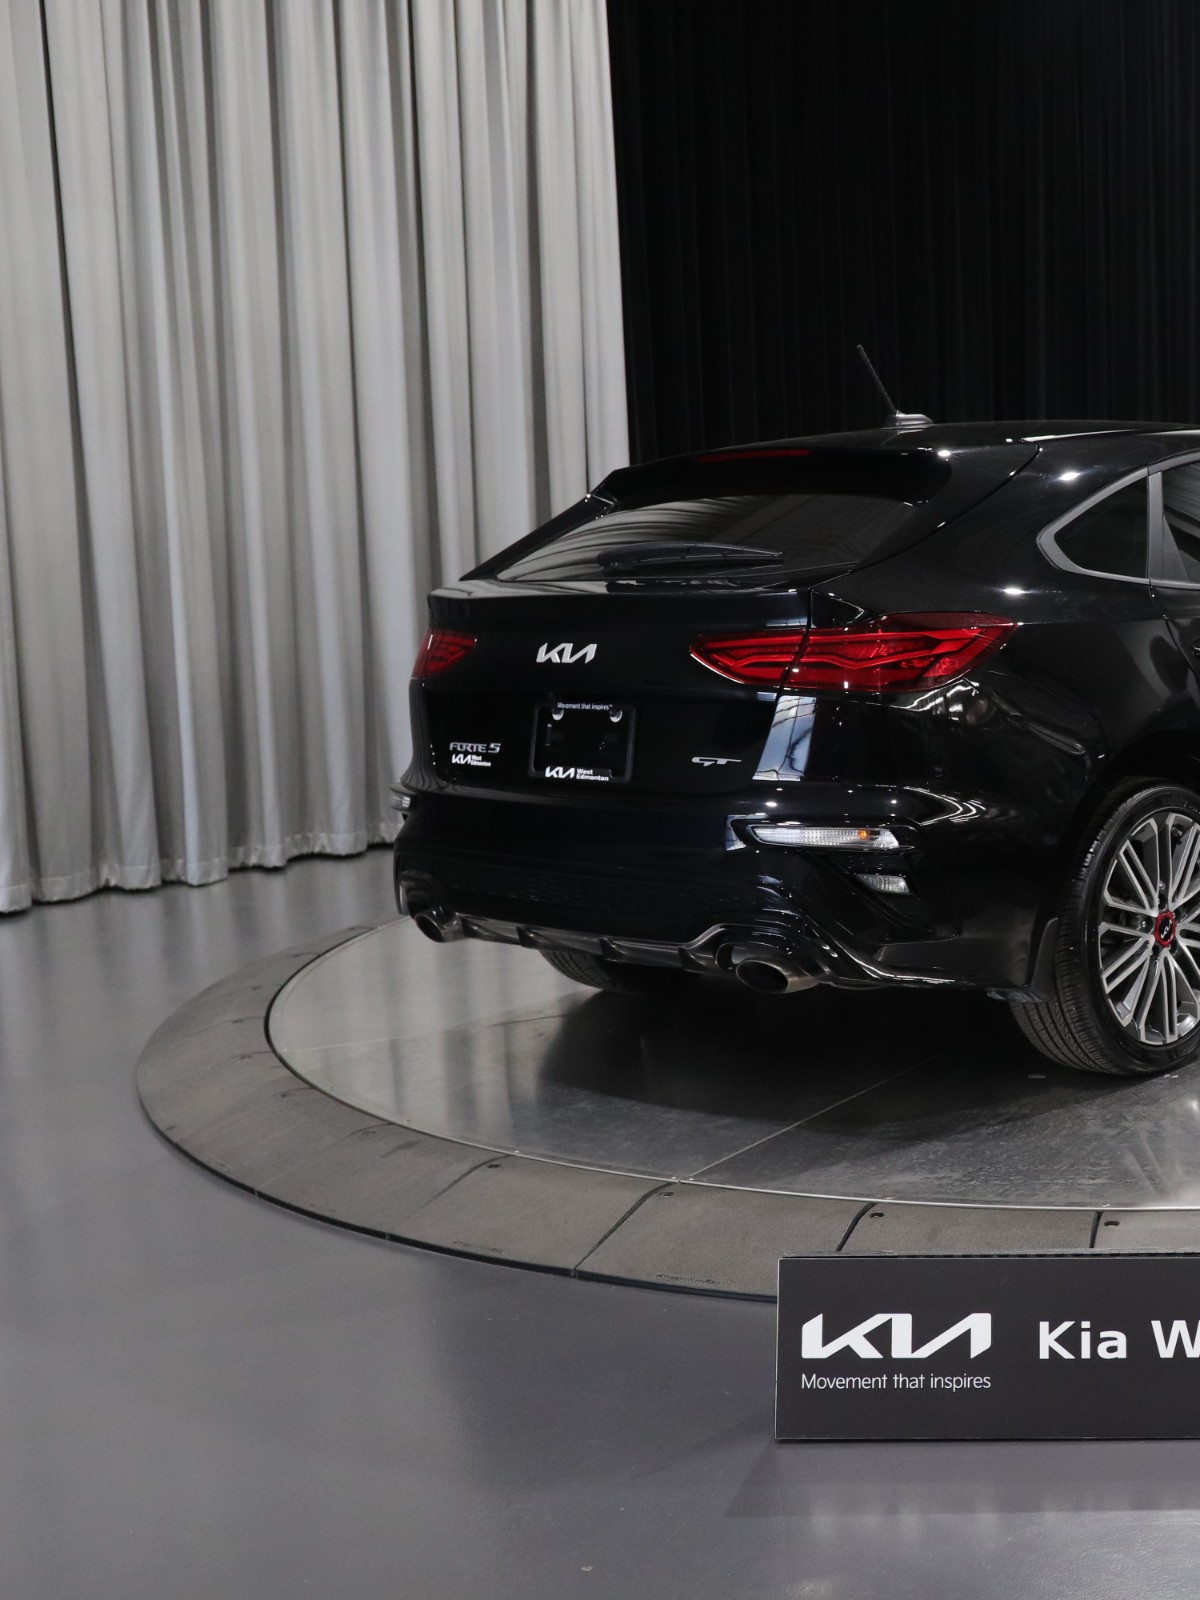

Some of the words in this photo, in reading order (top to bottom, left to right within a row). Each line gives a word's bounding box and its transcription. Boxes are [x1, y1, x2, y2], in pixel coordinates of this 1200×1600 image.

[557, 702, 581, 710] Movement
[581, 702, 591, 710] that
[449, 741, 487, 753] FORTE
[691, 756, 742, 767] GT
[576, 773, 609, 782] Edmonton
[1039, 1320, 1127, 1360] Kia
[801, 1373, 888, 1390] Movement
[893, 1372, 926, 1389] that
[930, 1373, 992, 1393] inspires
